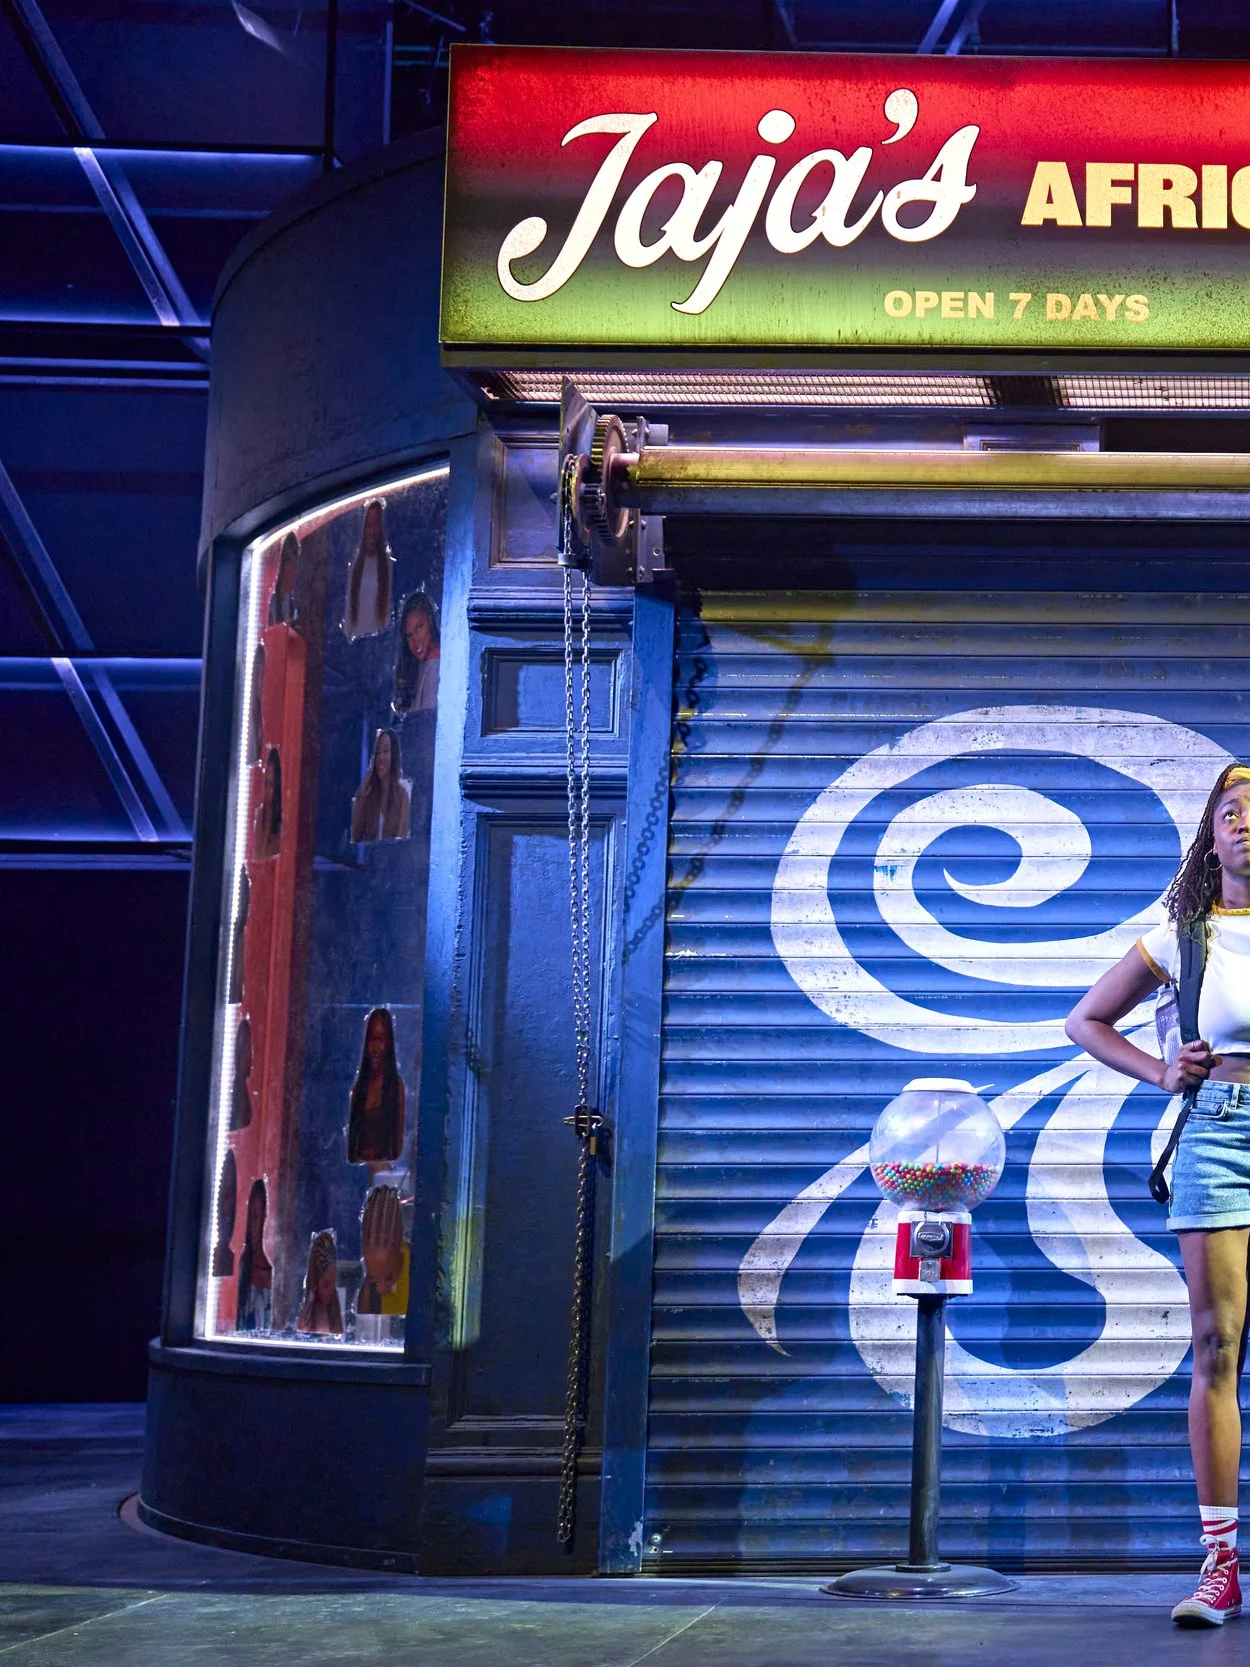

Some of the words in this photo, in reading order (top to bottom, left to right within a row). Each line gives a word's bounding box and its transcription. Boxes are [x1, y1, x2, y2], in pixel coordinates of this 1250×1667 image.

[496, 88, 980, 316] Jaja's
[884, 290, 995, 319] OPEN
[1008, 292, 1032, 319] 7
[1046, 293, 1150, 322] DAYS
